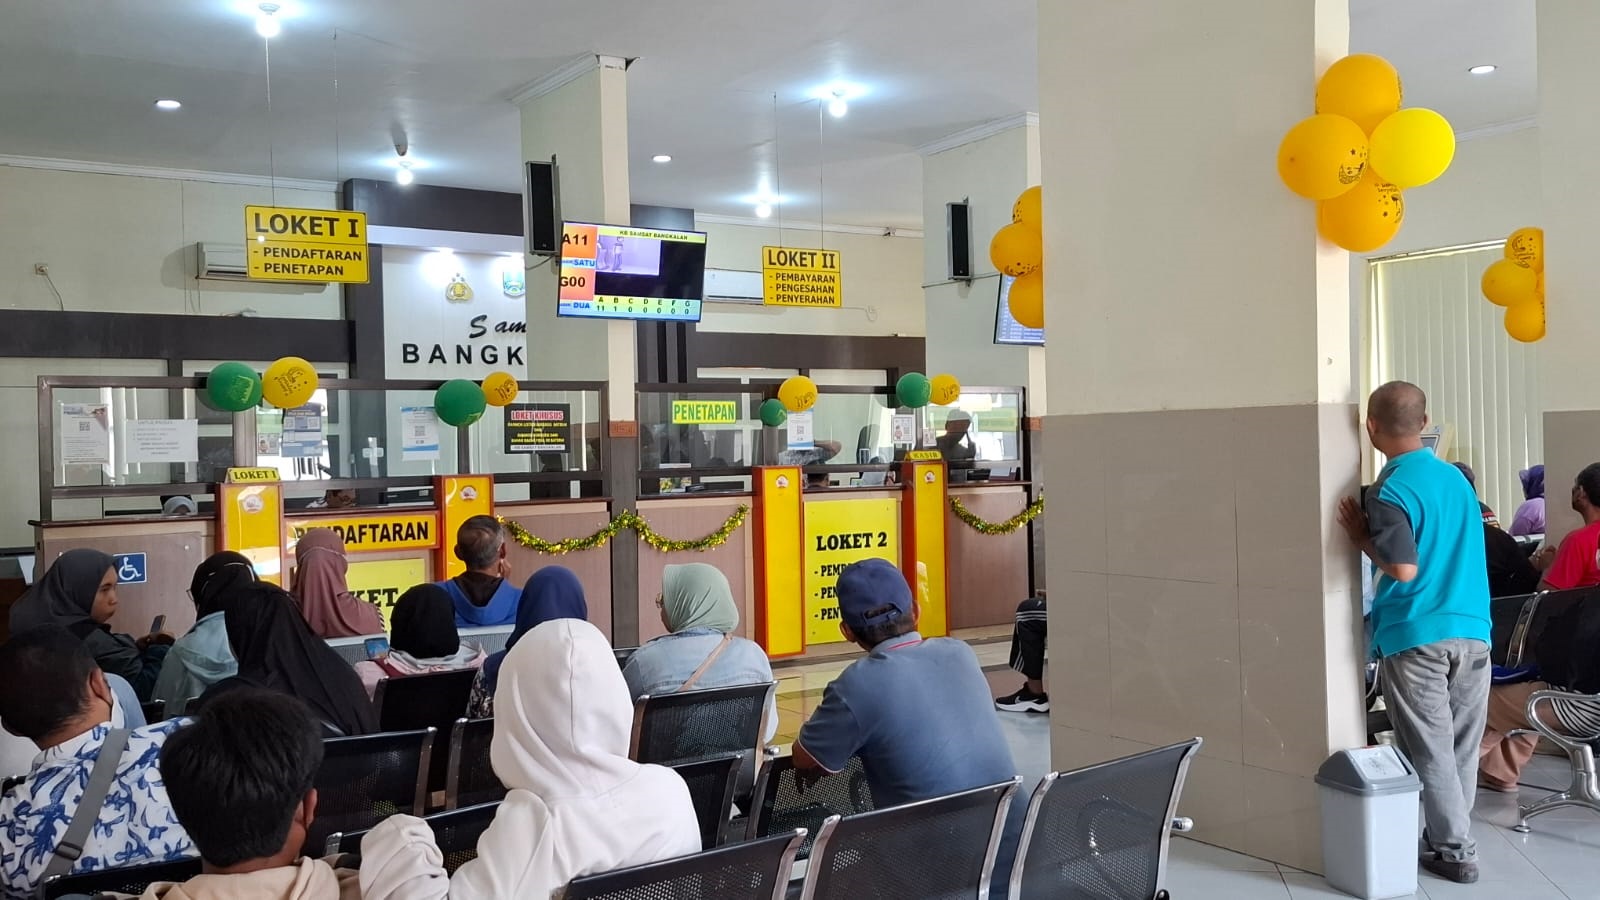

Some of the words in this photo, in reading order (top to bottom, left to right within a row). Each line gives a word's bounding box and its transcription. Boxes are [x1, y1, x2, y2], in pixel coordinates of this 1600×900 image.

[254, 212, 340, 237] LOKET
[347, 218, 359, 238] I
[562, 233, 588, 246] A11
[263, 246, 362, 261] PENDAFTARAN
[768, 249, 817, 268] LOKET
[822, 253, 836, 269] II
[264, 262, 344, 275] PENETAPAN
[574, 259, 595, 267] SATU
[775, 272, 836, 283] PEMBAYARAN
[775, 283, 835, 294] PENGESAHAN
[776, 293, 836, 304] PENYERAHAN
[402, 343, 524, 365] BANGK
[674, 403, 735, 420] PENETAPAN
[233, 470, 269, 480] LOKET
[294, 521, 429, 545] PDAFTARAN
[816, 532, 873, 551] LOKET
[877, 531, 887, 547] 2
